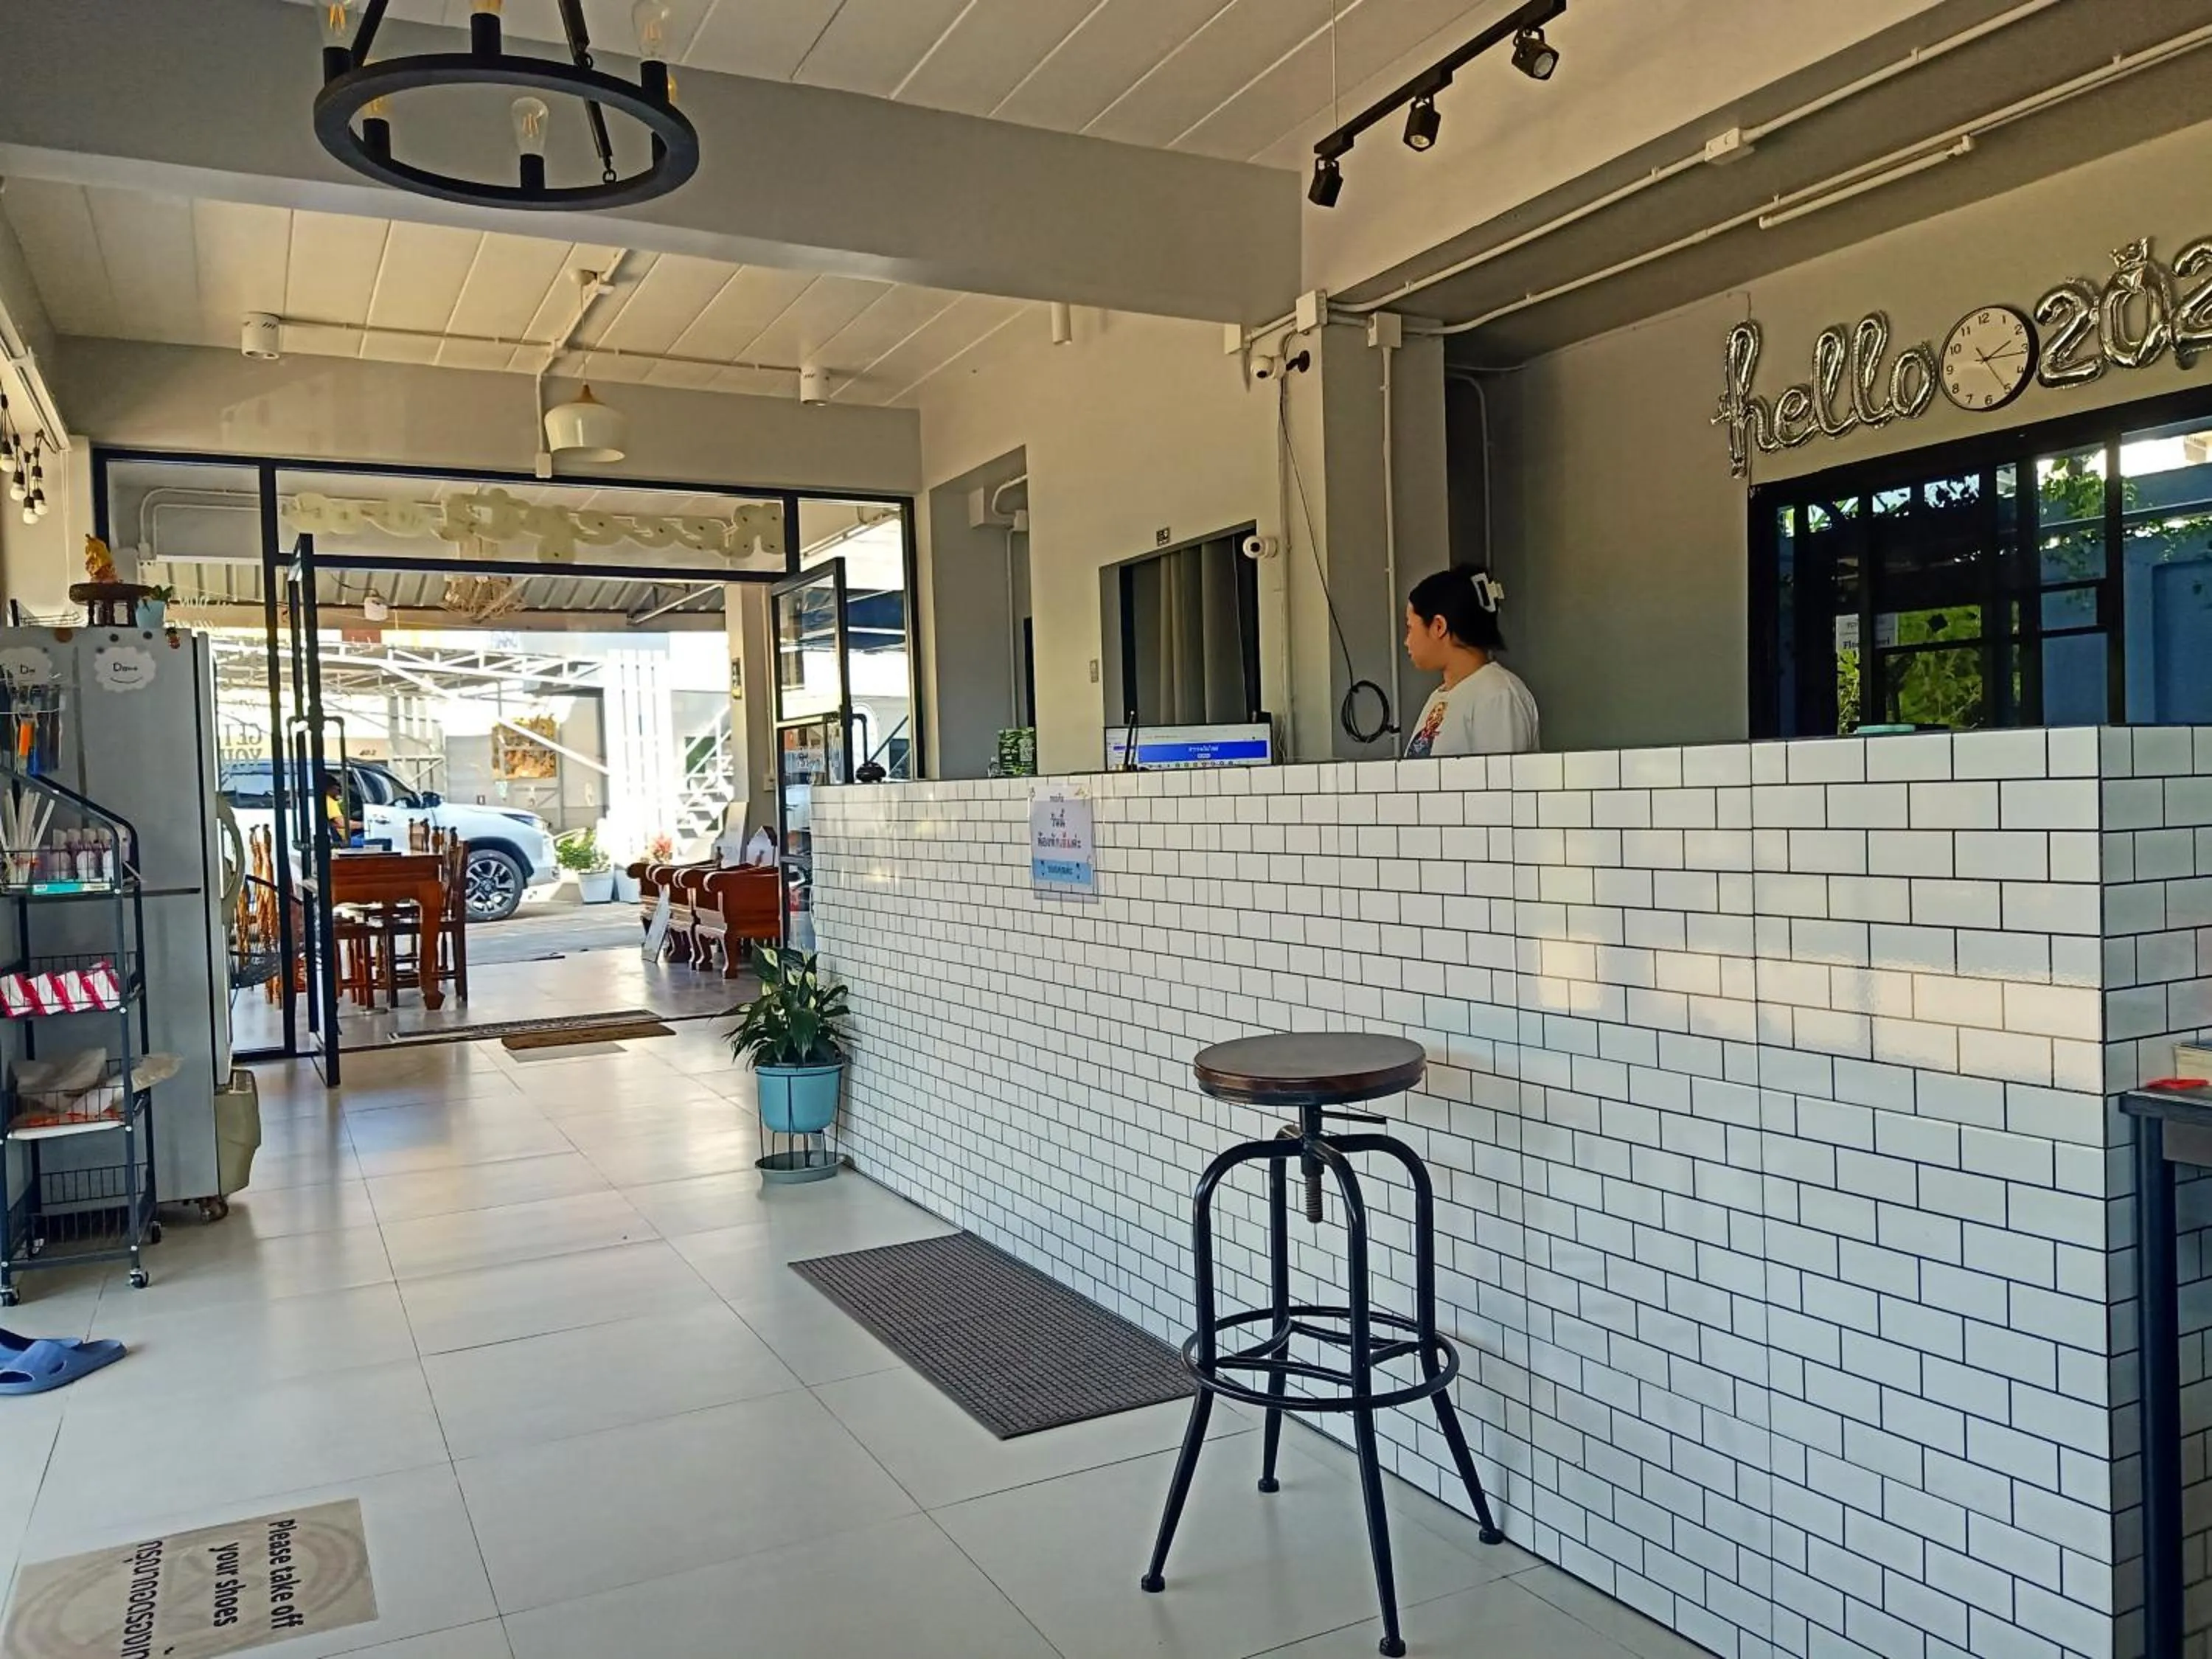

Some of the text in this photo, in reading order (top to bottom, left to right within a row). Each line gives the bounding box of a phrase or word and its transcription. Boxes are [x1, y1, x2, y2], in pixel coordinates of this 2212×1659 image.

[1978, 312, 1990, 324] 12
[2002, 315, 2006, 324] 1
[1961, 326, 1971, 336] 11
[2014, 324, 2023, 335] 2
[1950, 343, 1962, 355] 10
[2021, 343, 2028, 353] 3
[1946, 365, 1954, 375] 9
[2017, 366, 2024, 374] 4
[1952, 383, 1960, 394] 8
[2004, 383, 2012, 394] 5
[1965, 394, 1974, 404] 7
[1984, 394, 1993, 406] 6
[268, 1519, 305, 1630] Please take off
[208, 1542, 247, 1627] your shoes
